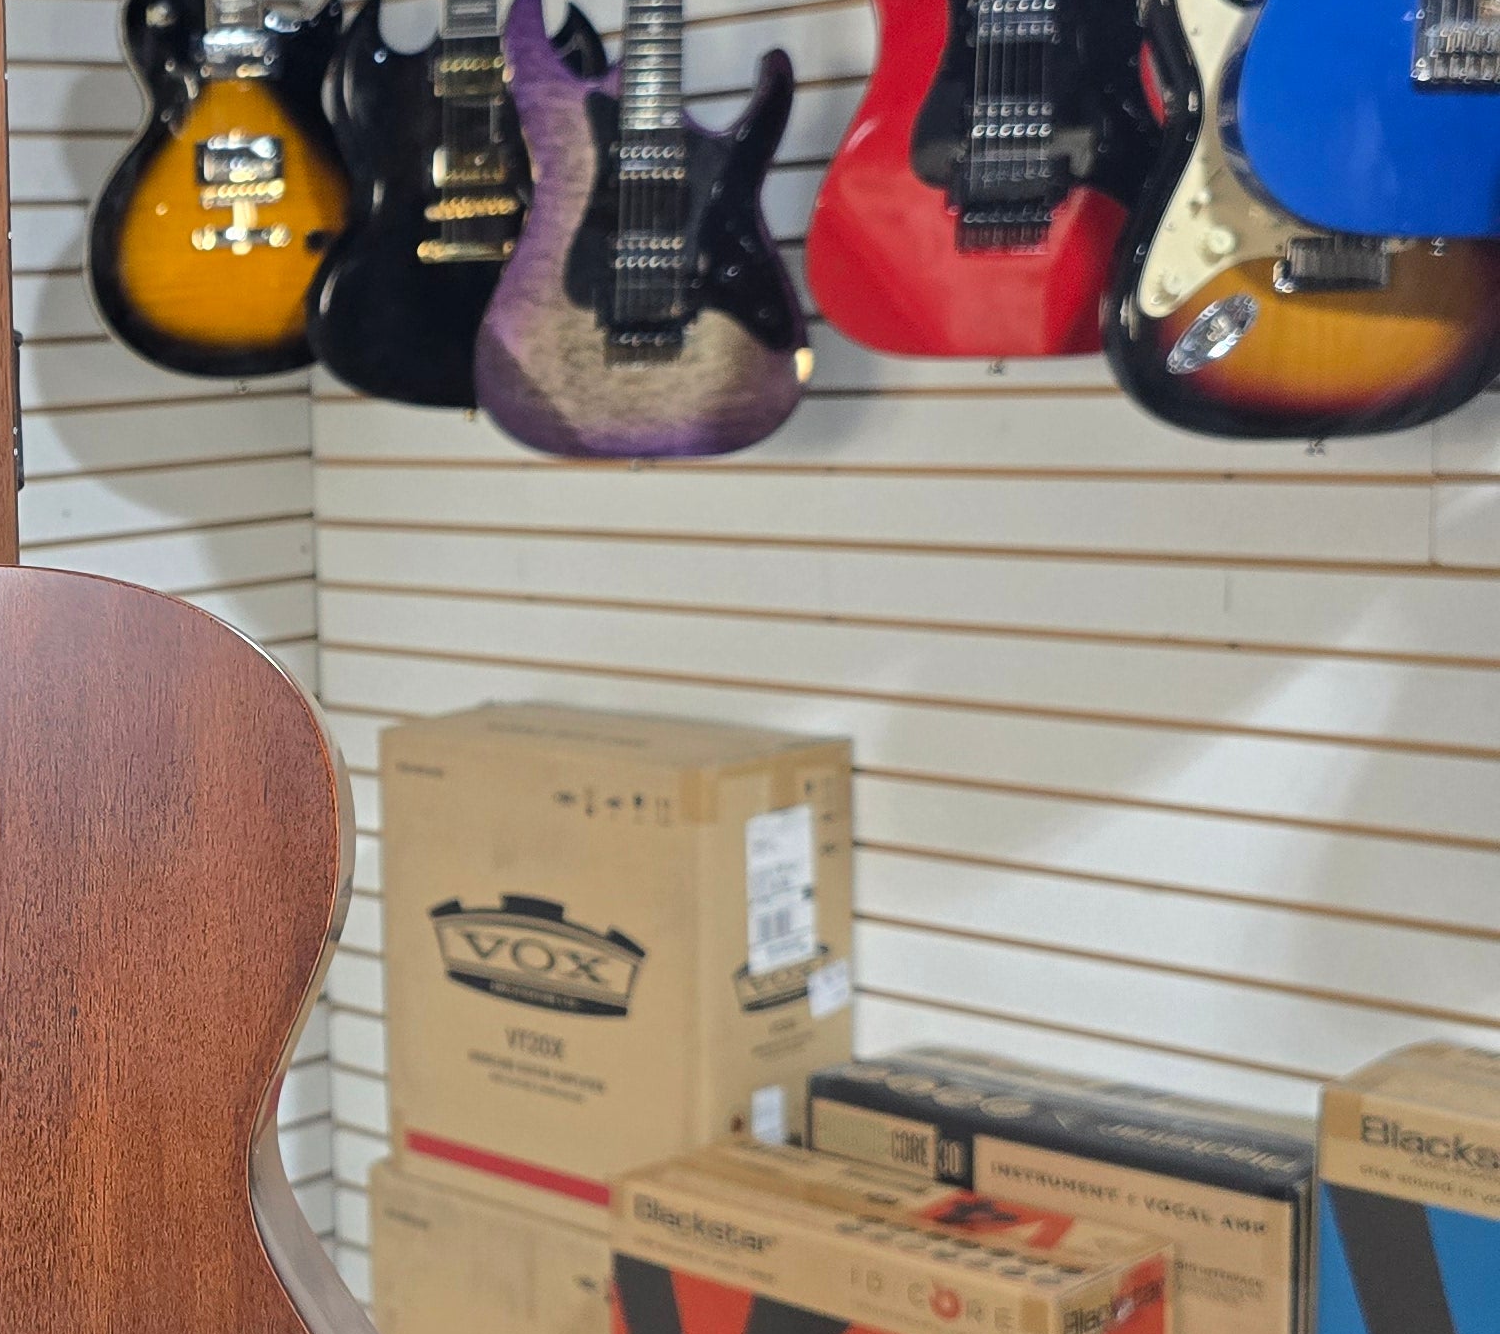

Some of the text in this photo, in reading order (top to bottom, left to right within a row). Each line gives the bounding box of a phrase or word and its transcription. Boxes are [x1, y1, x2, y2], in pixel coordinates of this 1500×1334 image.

[461, 928, 611, 984] VOX
[633, 1192, 772, 1254] Blackstar
[991, 1160, 1118, 1200] INSTRUMENT
[1144, 1193, 1211, 1225] VOCAL
[1219, 1211, 1268, 1235] AMP
